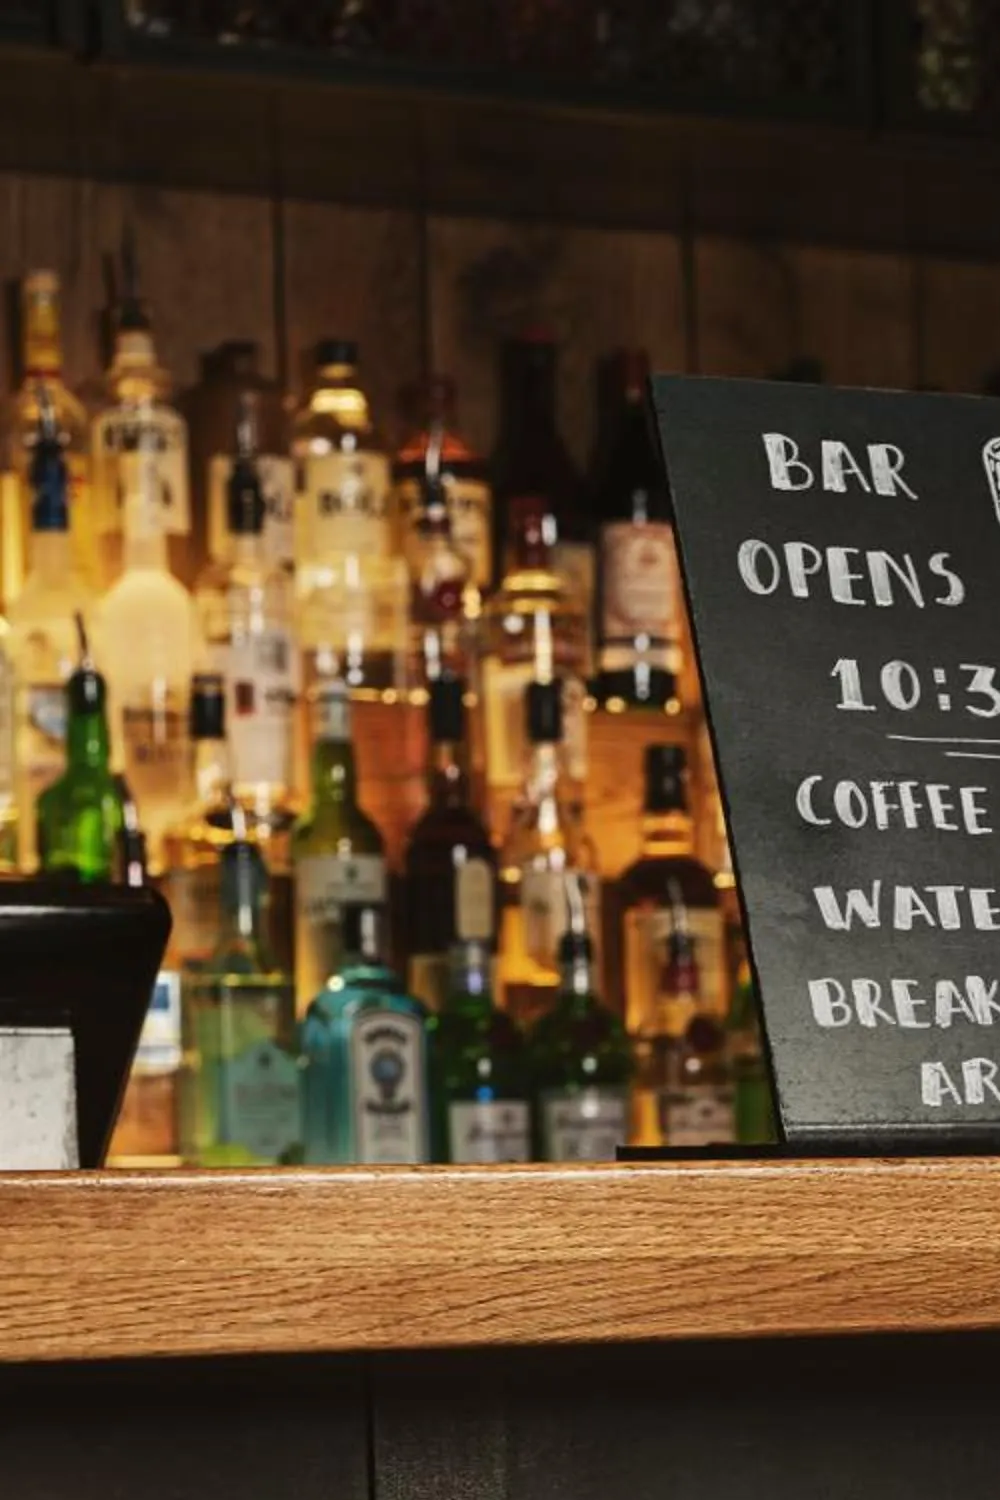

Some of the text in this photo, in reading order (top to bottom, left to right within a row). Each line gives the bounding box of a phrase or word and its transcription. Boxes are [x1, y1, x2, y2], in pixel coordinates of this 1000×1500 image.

[762, 432, 918, 500] BAR
[737, 539, 965, 609] OPENS
[795, 774, 994, 836] COFFEE
